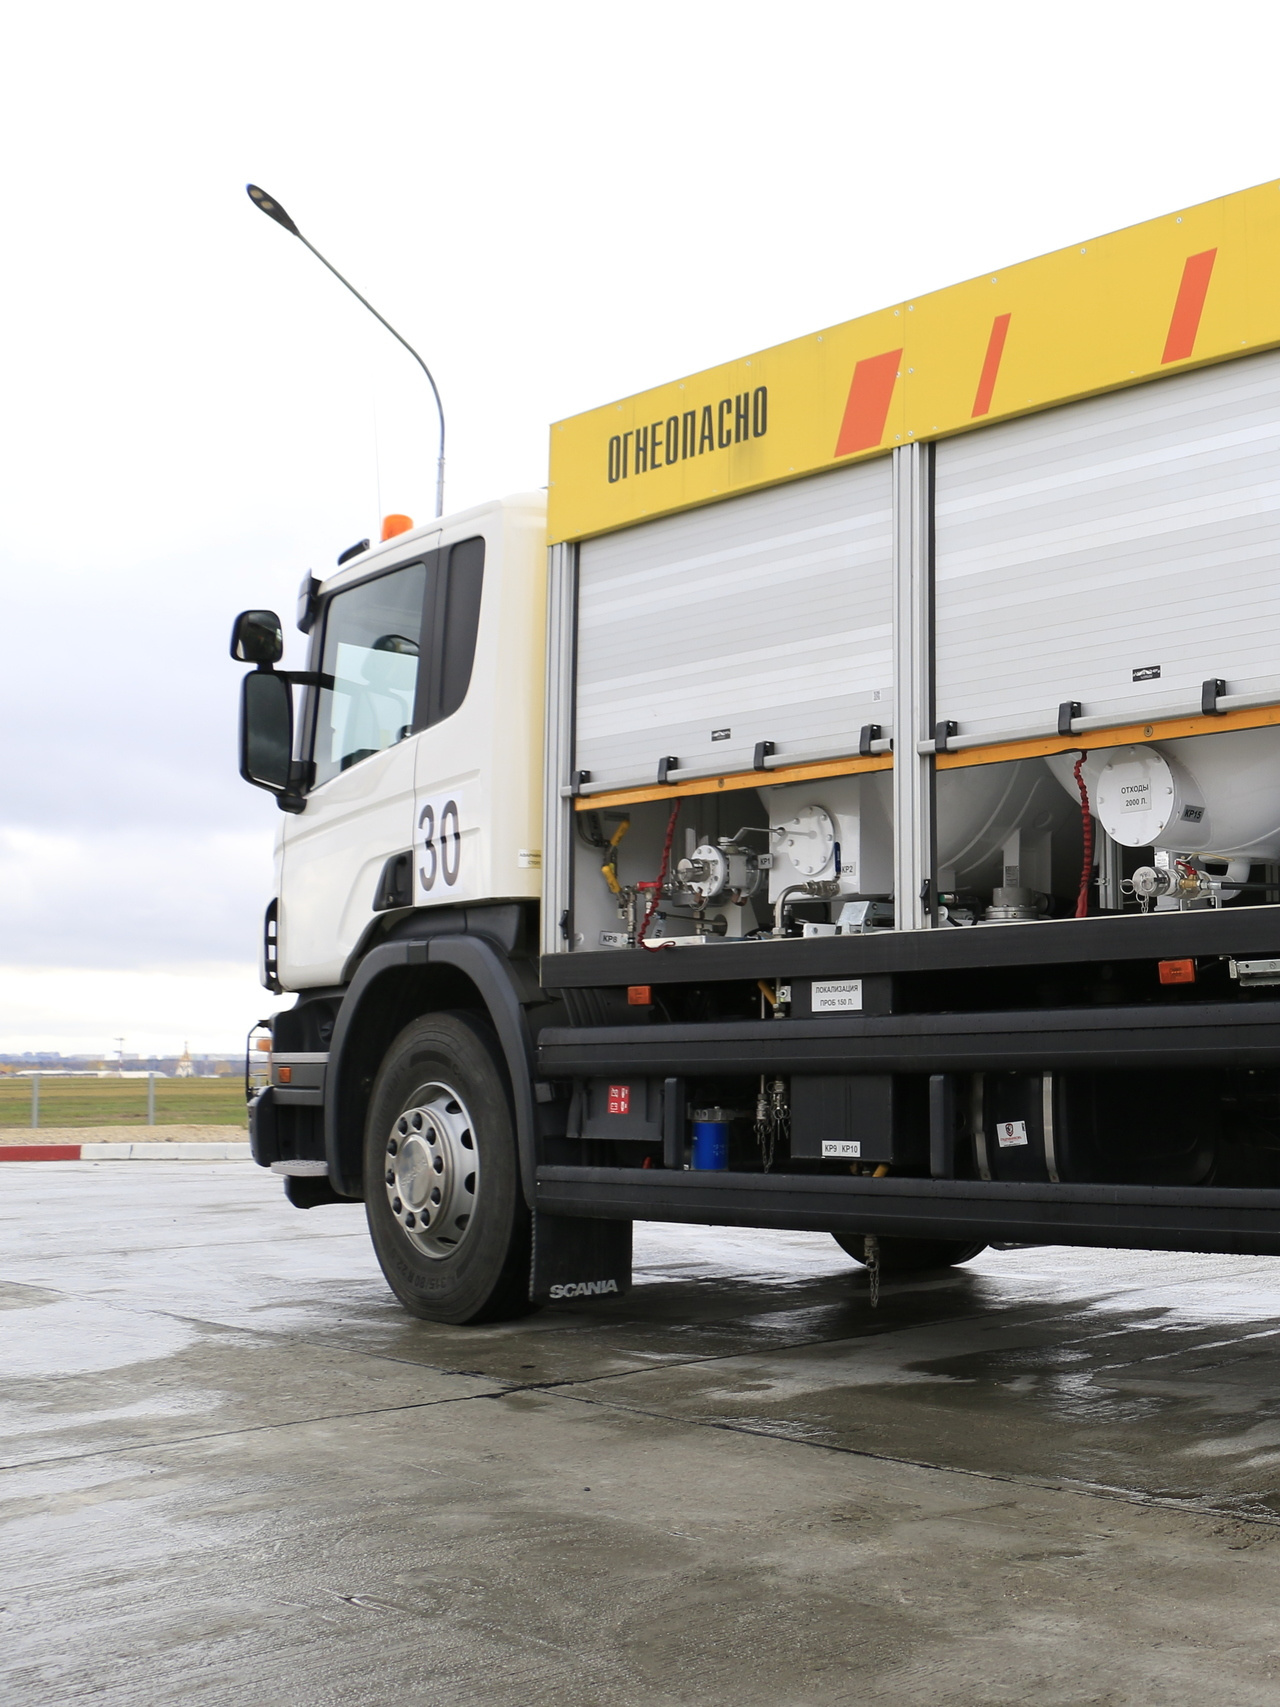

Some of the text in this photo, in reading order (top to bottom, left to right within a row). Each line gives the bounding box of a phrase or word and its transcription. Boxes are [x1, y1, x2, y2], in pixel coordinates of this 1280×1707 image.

[608, 386, 768, 484] ОГНЕОПАСНО
[1121, 784, 1149, 794] ОТХОДЫ
[1125, 798, 1140, 807] 2000
[418, 800, 461, 892] 30
[815, 984, 859, 993] ЛОКАЛИЗАЦИЯ
[820, 998, 836, 1006] ПРОБ
[837, 998, 847, 1006] 150
[548, 1278, 619, 1299] SCANIA
